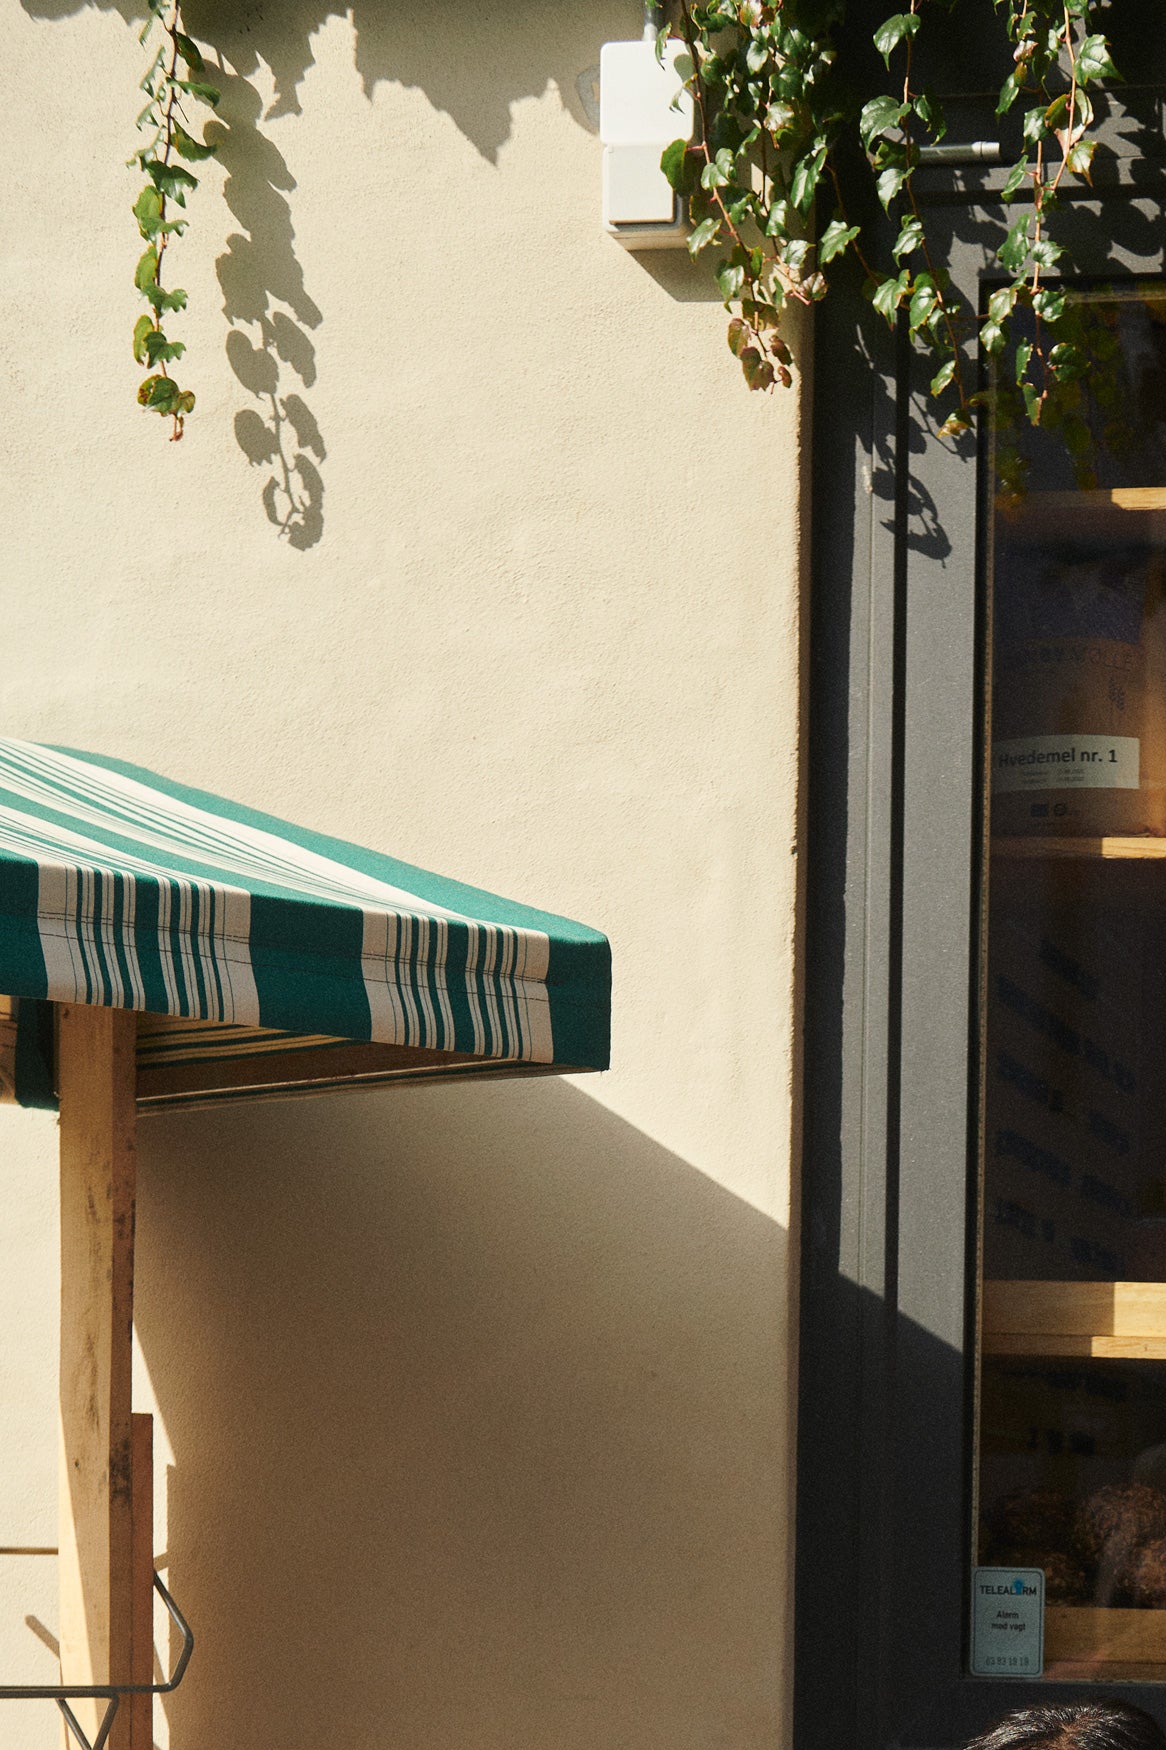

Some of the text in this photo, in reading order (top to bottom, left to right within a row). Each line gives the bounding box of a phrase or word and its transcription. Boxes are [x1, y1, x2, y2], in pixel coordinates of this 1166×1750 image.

[1000, 747, 1118, 768] Hvedemel nr. 1
[980, 1585, 1037, 1596] TELEALRM
